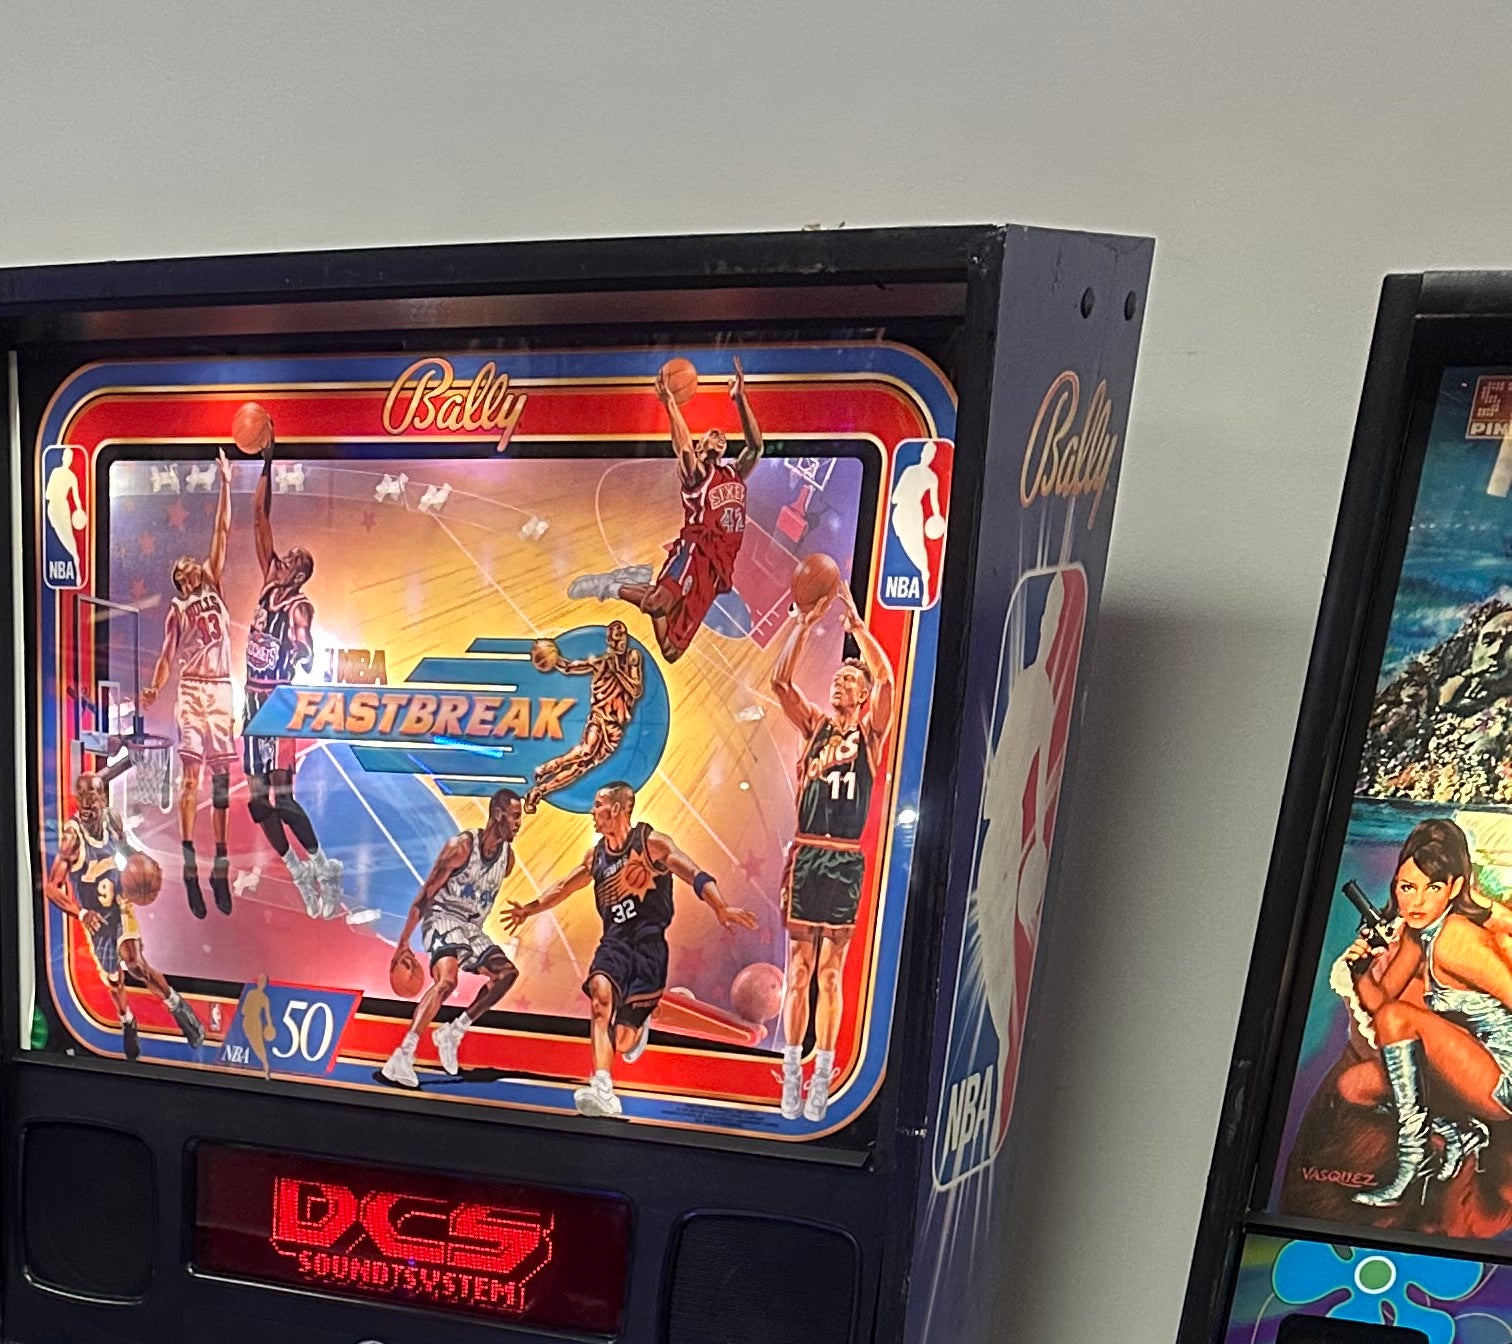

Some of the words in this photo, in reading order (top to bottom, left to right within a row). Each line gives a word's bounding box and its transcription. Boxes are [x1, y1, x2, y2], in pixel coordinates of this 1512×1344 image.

[382, 357, 527, 451] Bally
[1019, 370, 1119, 531] Bally
[50, 561, 76, 580] NBA
[886, 576, 921, 599] NBA
[337, 648, 388, 685] NBA
[287, 692, 577, 741] FASTBREAK
[826, 771, 856, 800] 11
[611, 898, 637, 924] 32
[272, 1000, 334, 1062] 50
[221, 1045, 250, 1065] NBA
[944, 1066, 999, 1154] NBA
[1301, 1166, 1378, 1187] VASQUEZ
[273, 1177, 546, 1274] DCS
[299, 1251, 388, 1287] SOUND
